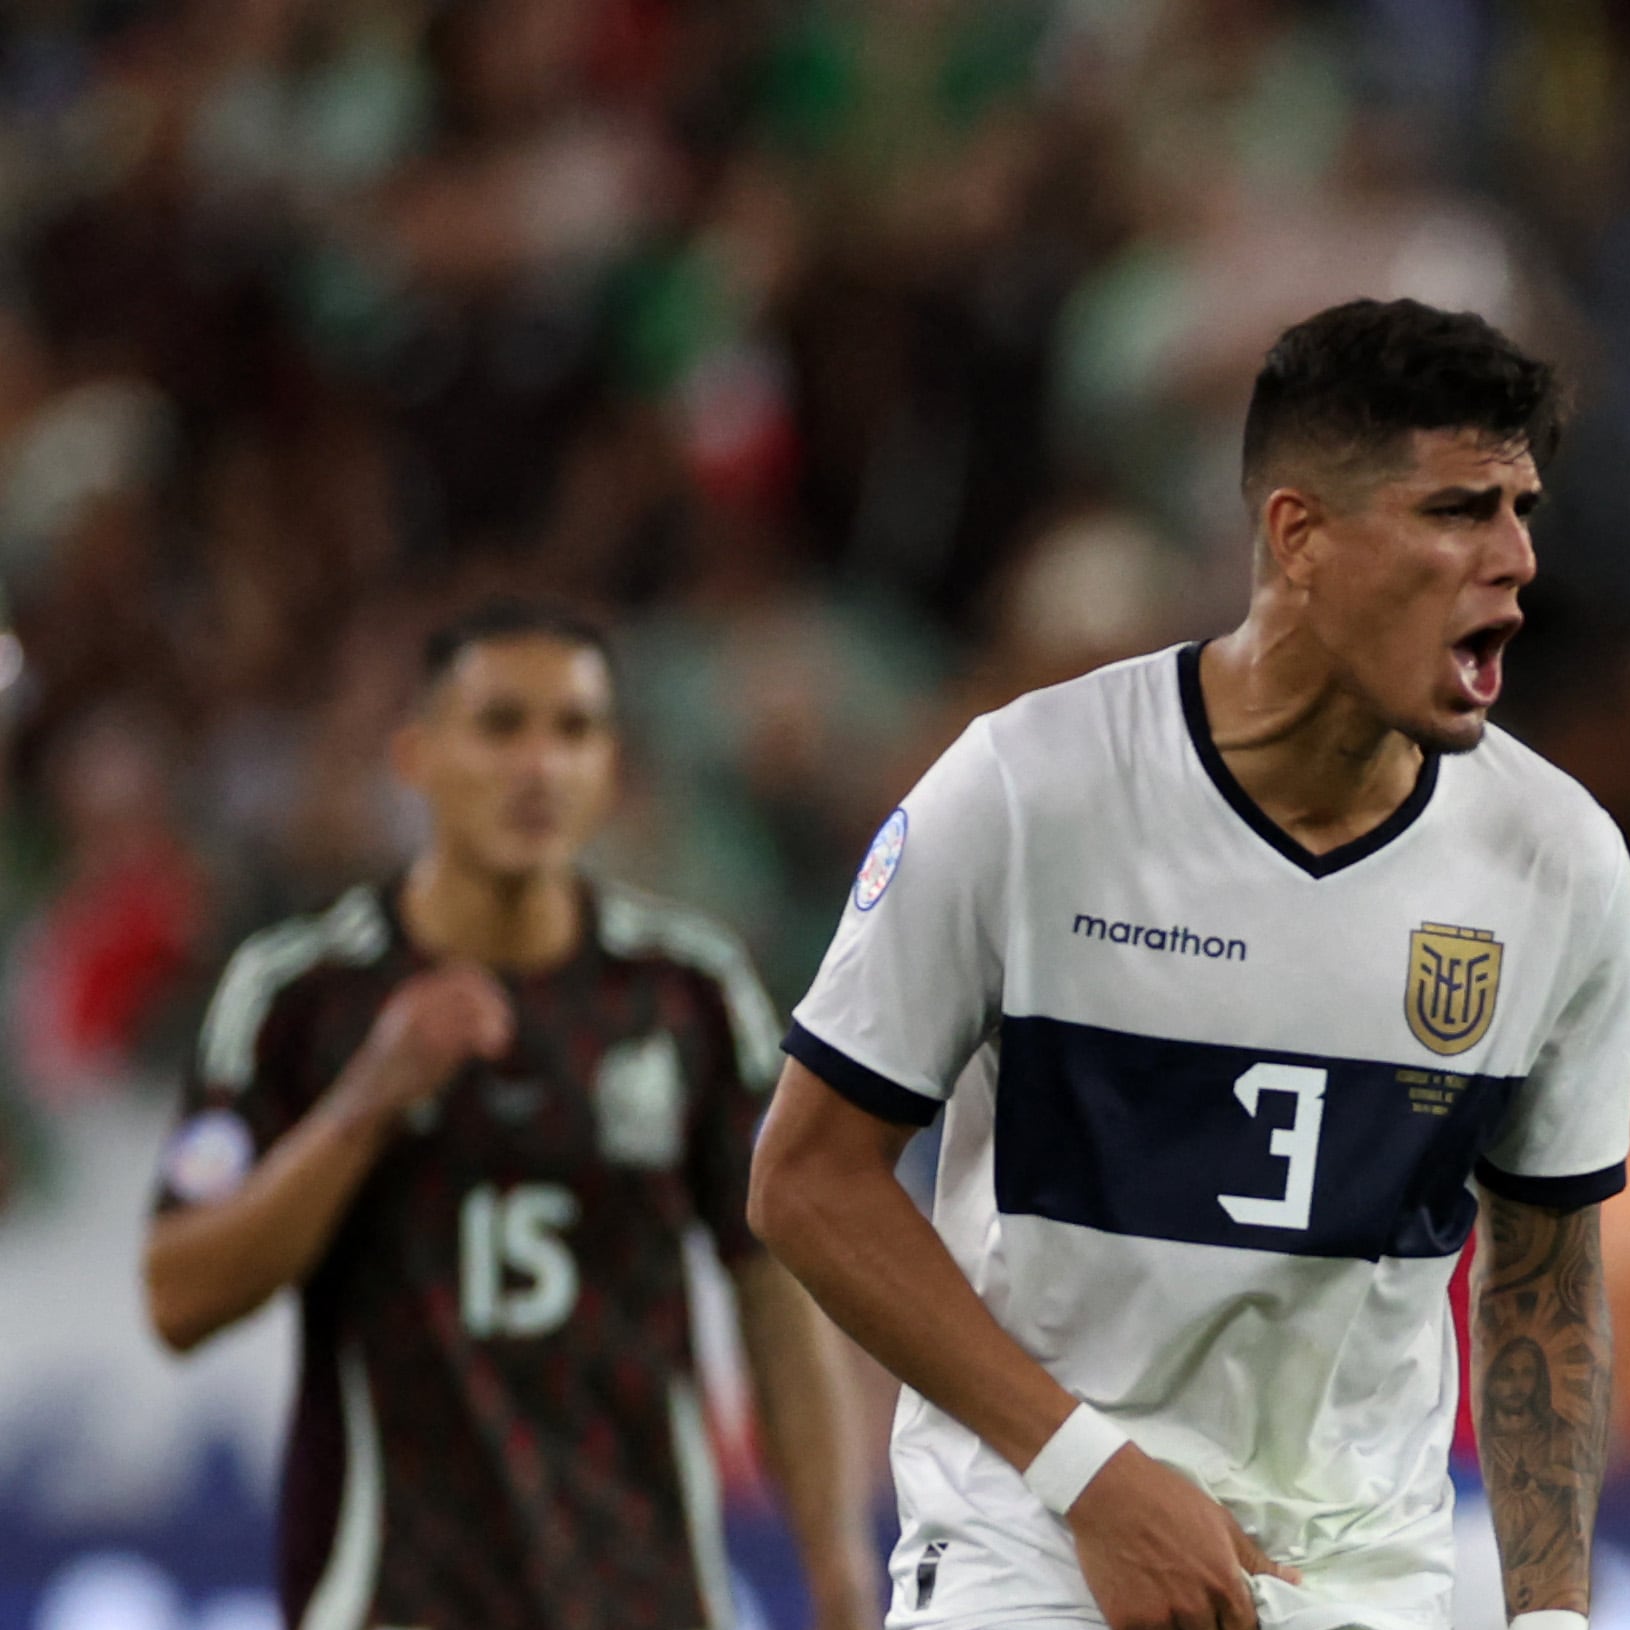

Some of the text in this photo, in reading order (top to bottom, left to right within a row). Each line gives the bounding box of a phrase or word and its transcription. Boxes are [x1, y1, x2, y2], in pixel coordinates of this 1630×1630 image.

[1072, 913, 1247, 962] marathon
[1217, 1061, 1329, 1231] 3
[459, 1182, 583, 1338] 15
